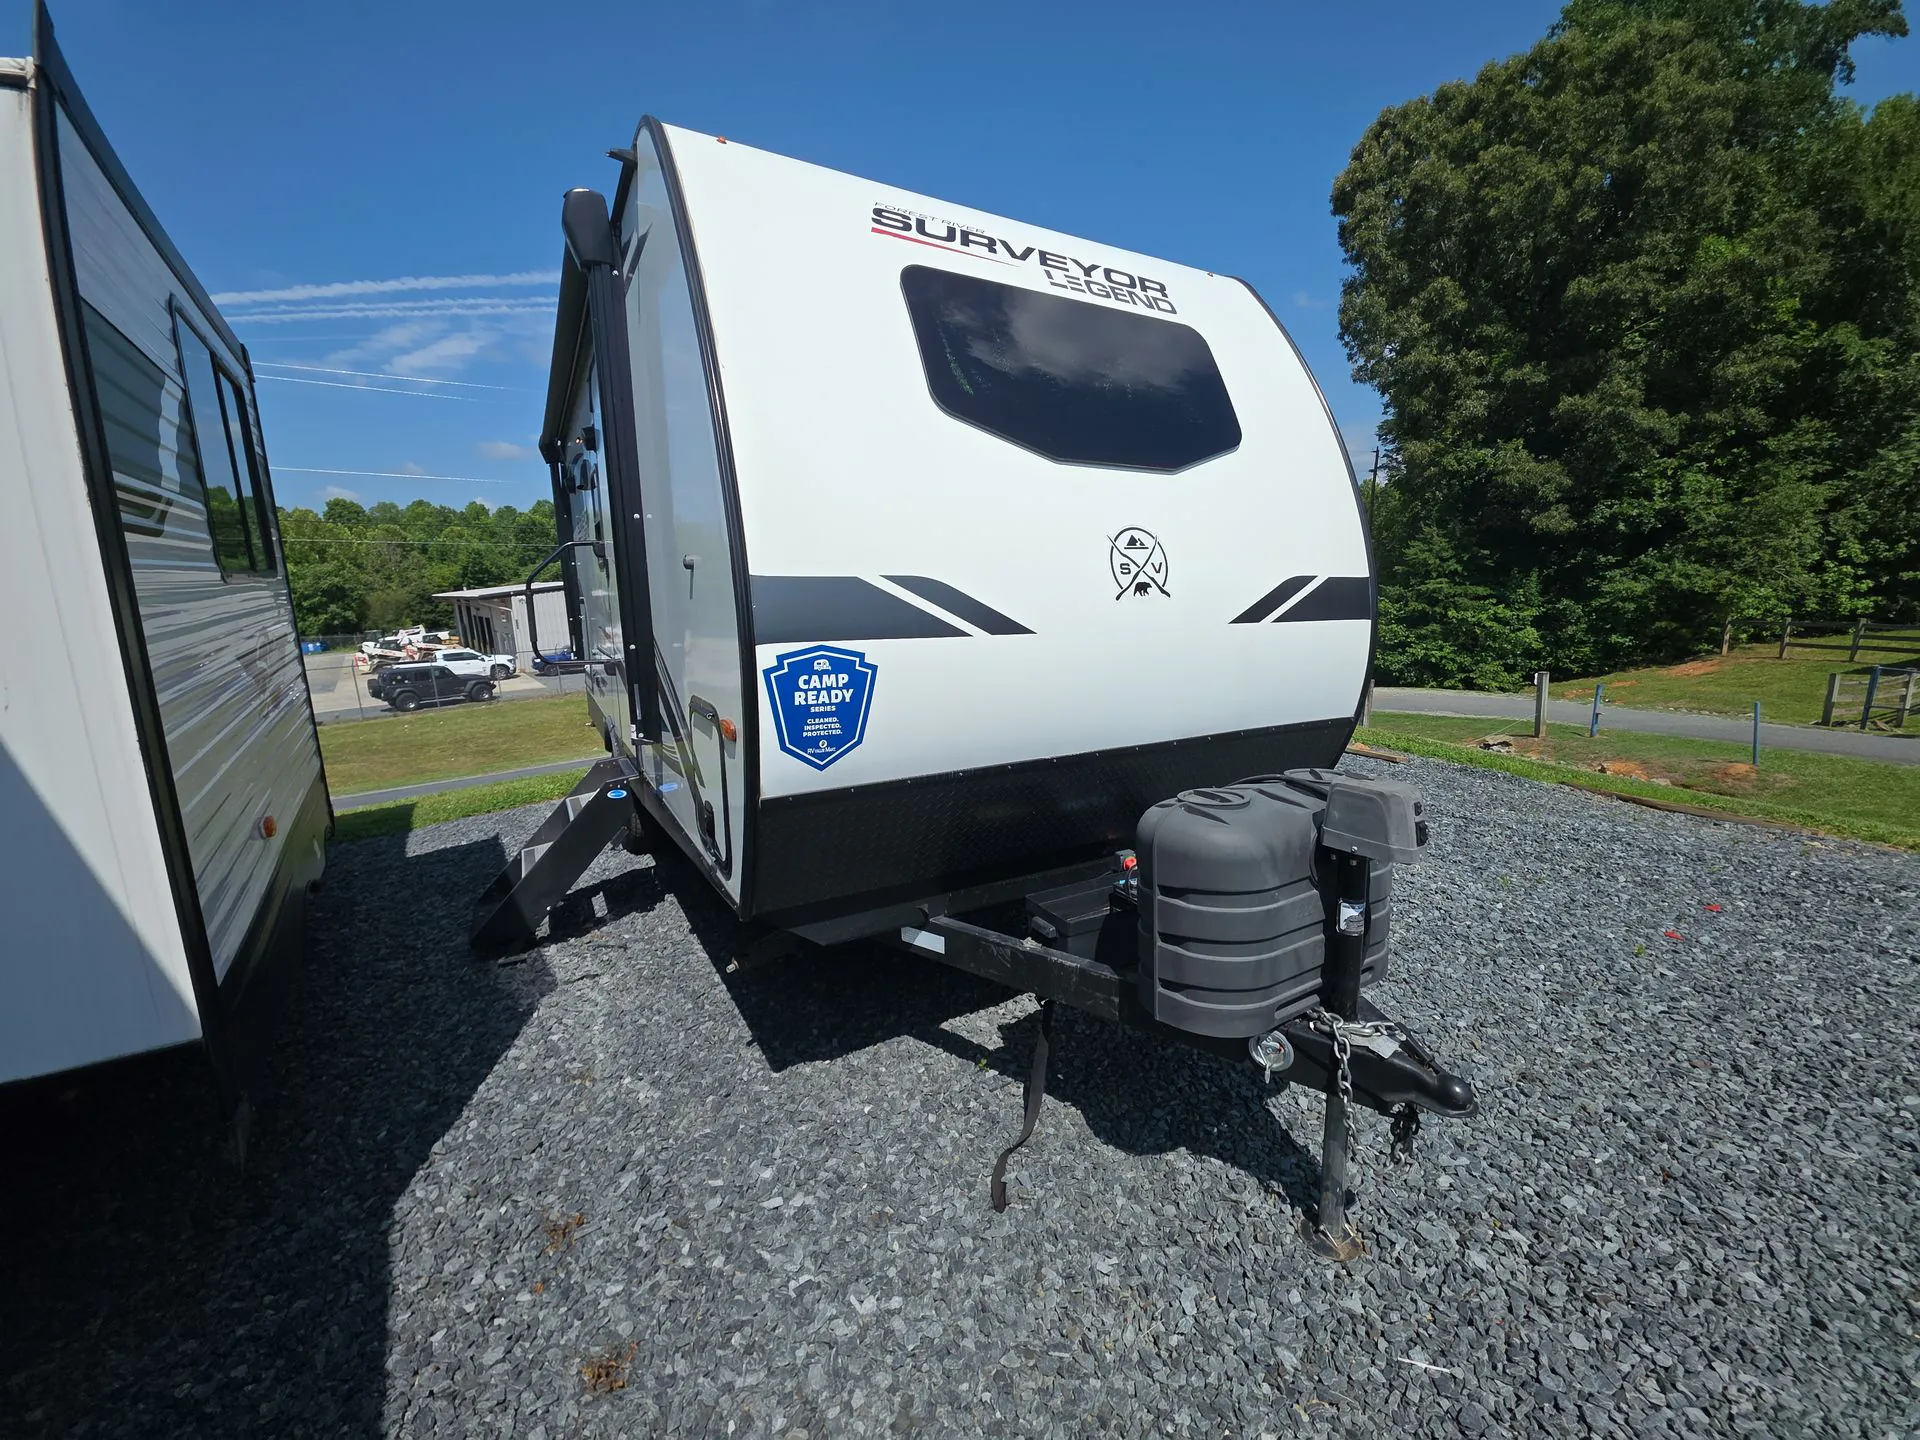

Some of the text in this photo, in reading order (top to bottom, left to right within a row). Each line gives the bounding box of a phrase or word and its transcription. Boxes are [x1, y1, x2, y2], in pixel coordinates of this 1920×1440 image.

[875, 202, 985, 234] FOREST RIVER
[871, 207, 1168, 299] SURVEYOR
[1043, 269, 1177, 315] LEGEND
[798, 673, 849, 689] CAMP
[794, 689, 854, 705] READY
[803, 729, 843, 737] PROTECTED.
[804, 723, 842, 731] INSPECTED.
